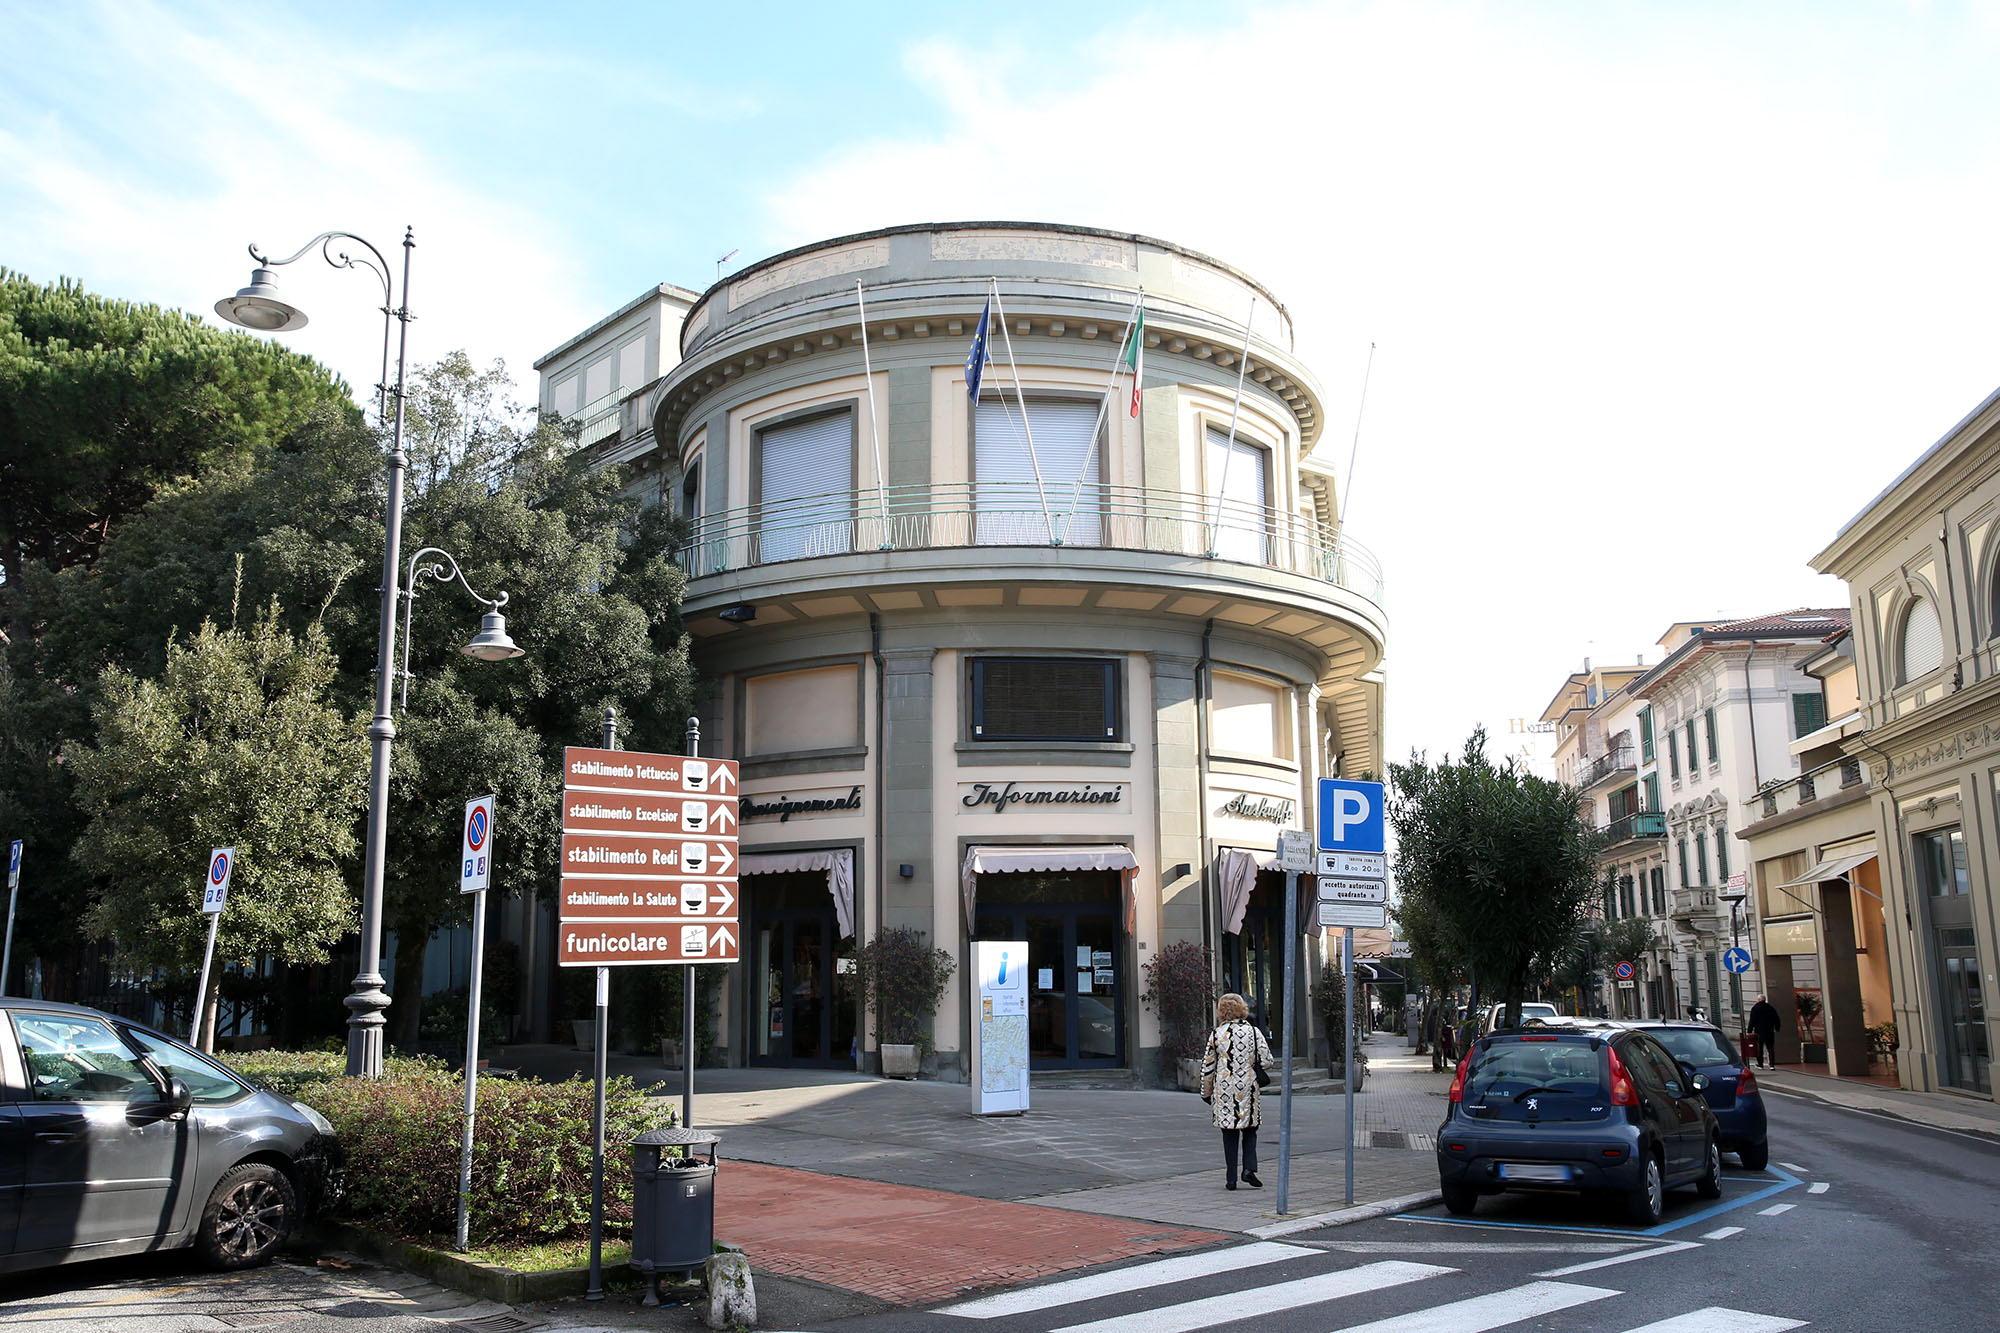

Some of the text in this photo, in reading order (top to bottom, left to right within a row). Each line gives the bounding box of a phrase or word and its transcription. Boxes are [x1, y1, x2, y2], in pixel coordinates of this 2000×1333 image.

[571, 761, 679, 781] stabilimento Tettuccio
[962, 782, 1122, 813] Informazioni
[569, 804, 679, 823] stabilimento Excelsior
[1333, 788, 1370, 842] P
[568, 847, 678, 865] stabilimento Redi
[1337, 890, 1366, 899] quadrante
[1349, 882, 1380, 890] autorizzati
[567, 892, 677, 906] stabilimento La Salute
[566, 932, 668, 953] funicolare
